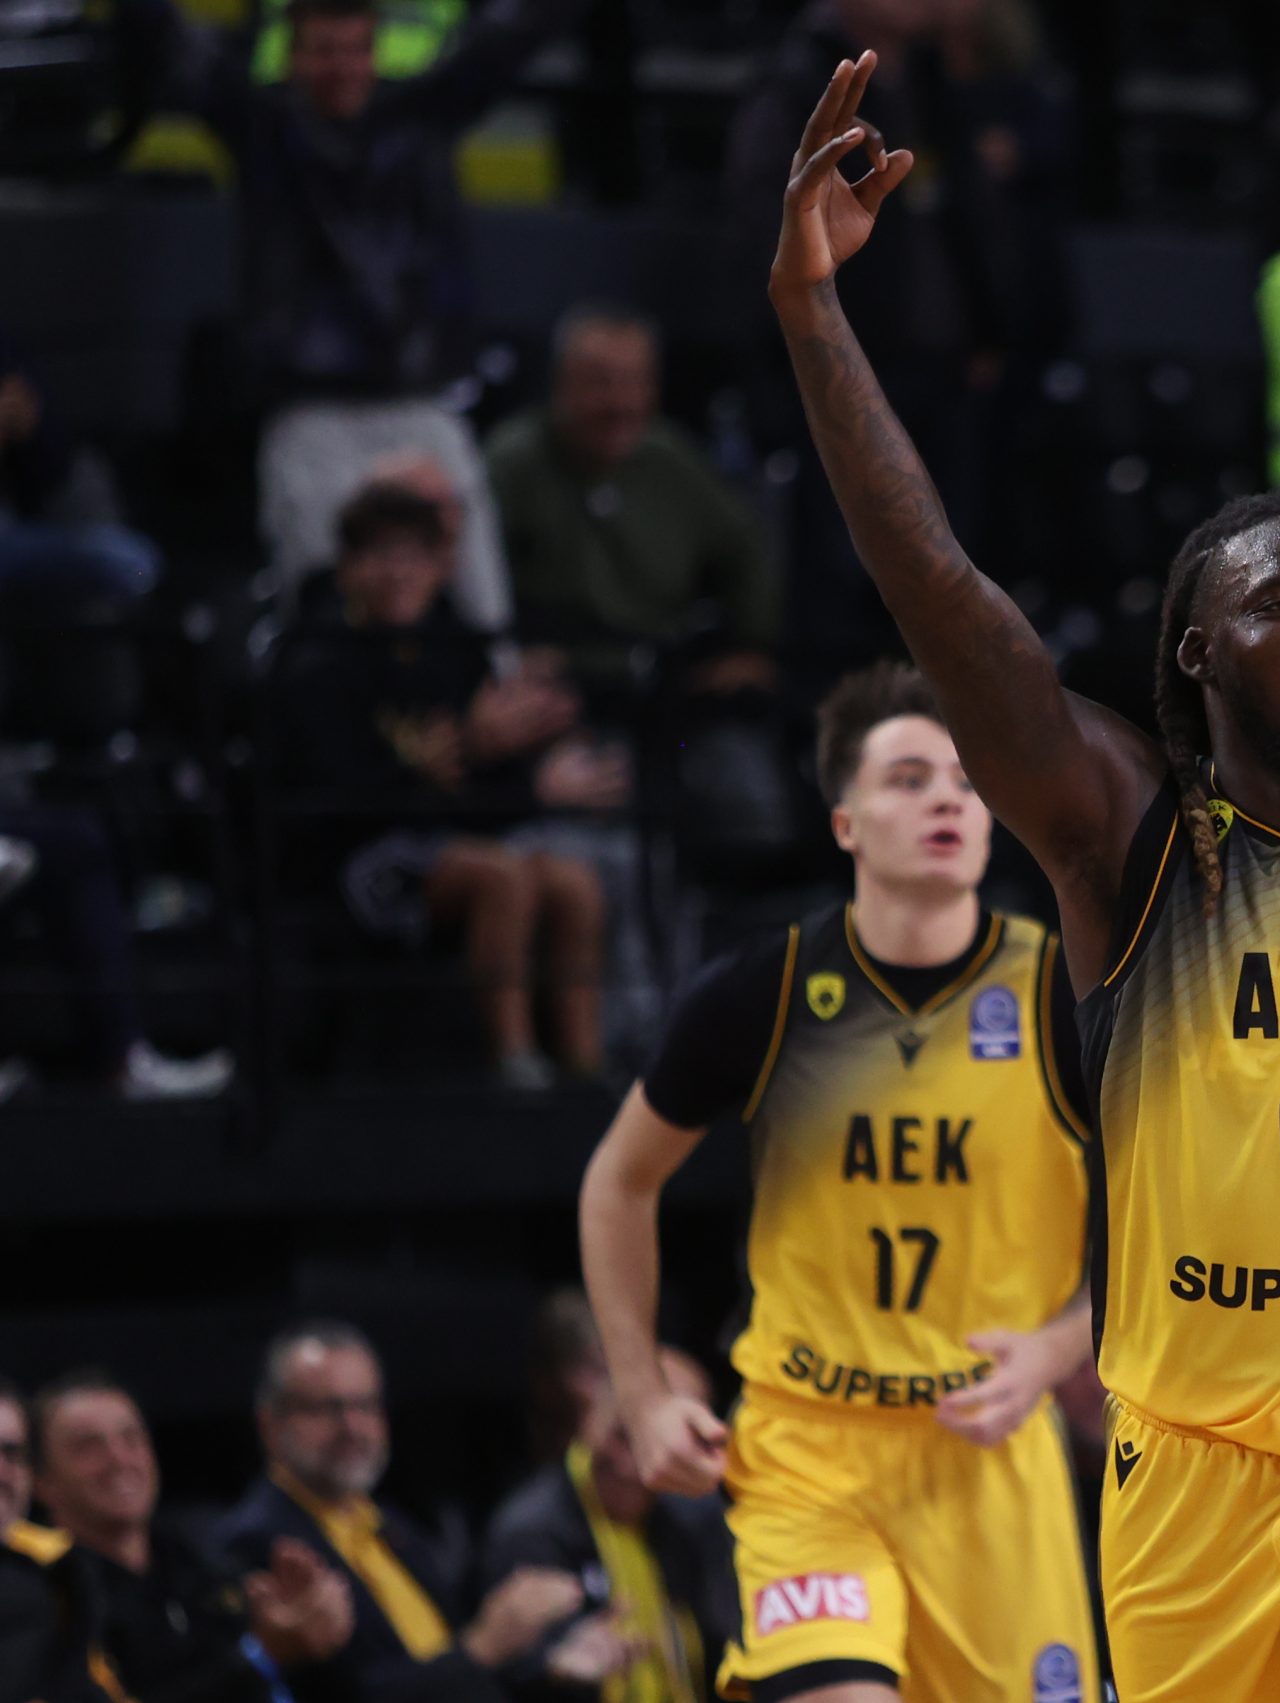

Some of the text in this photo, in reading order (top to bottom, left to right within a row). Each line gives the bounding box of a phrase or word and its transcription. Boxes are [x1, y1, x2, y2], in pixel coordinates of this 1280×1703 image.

[842, 1113, 972, 1185] AEK
[869, 1226, 941, 1313] 17
[757, 1574, 868, 1635] AVIS
